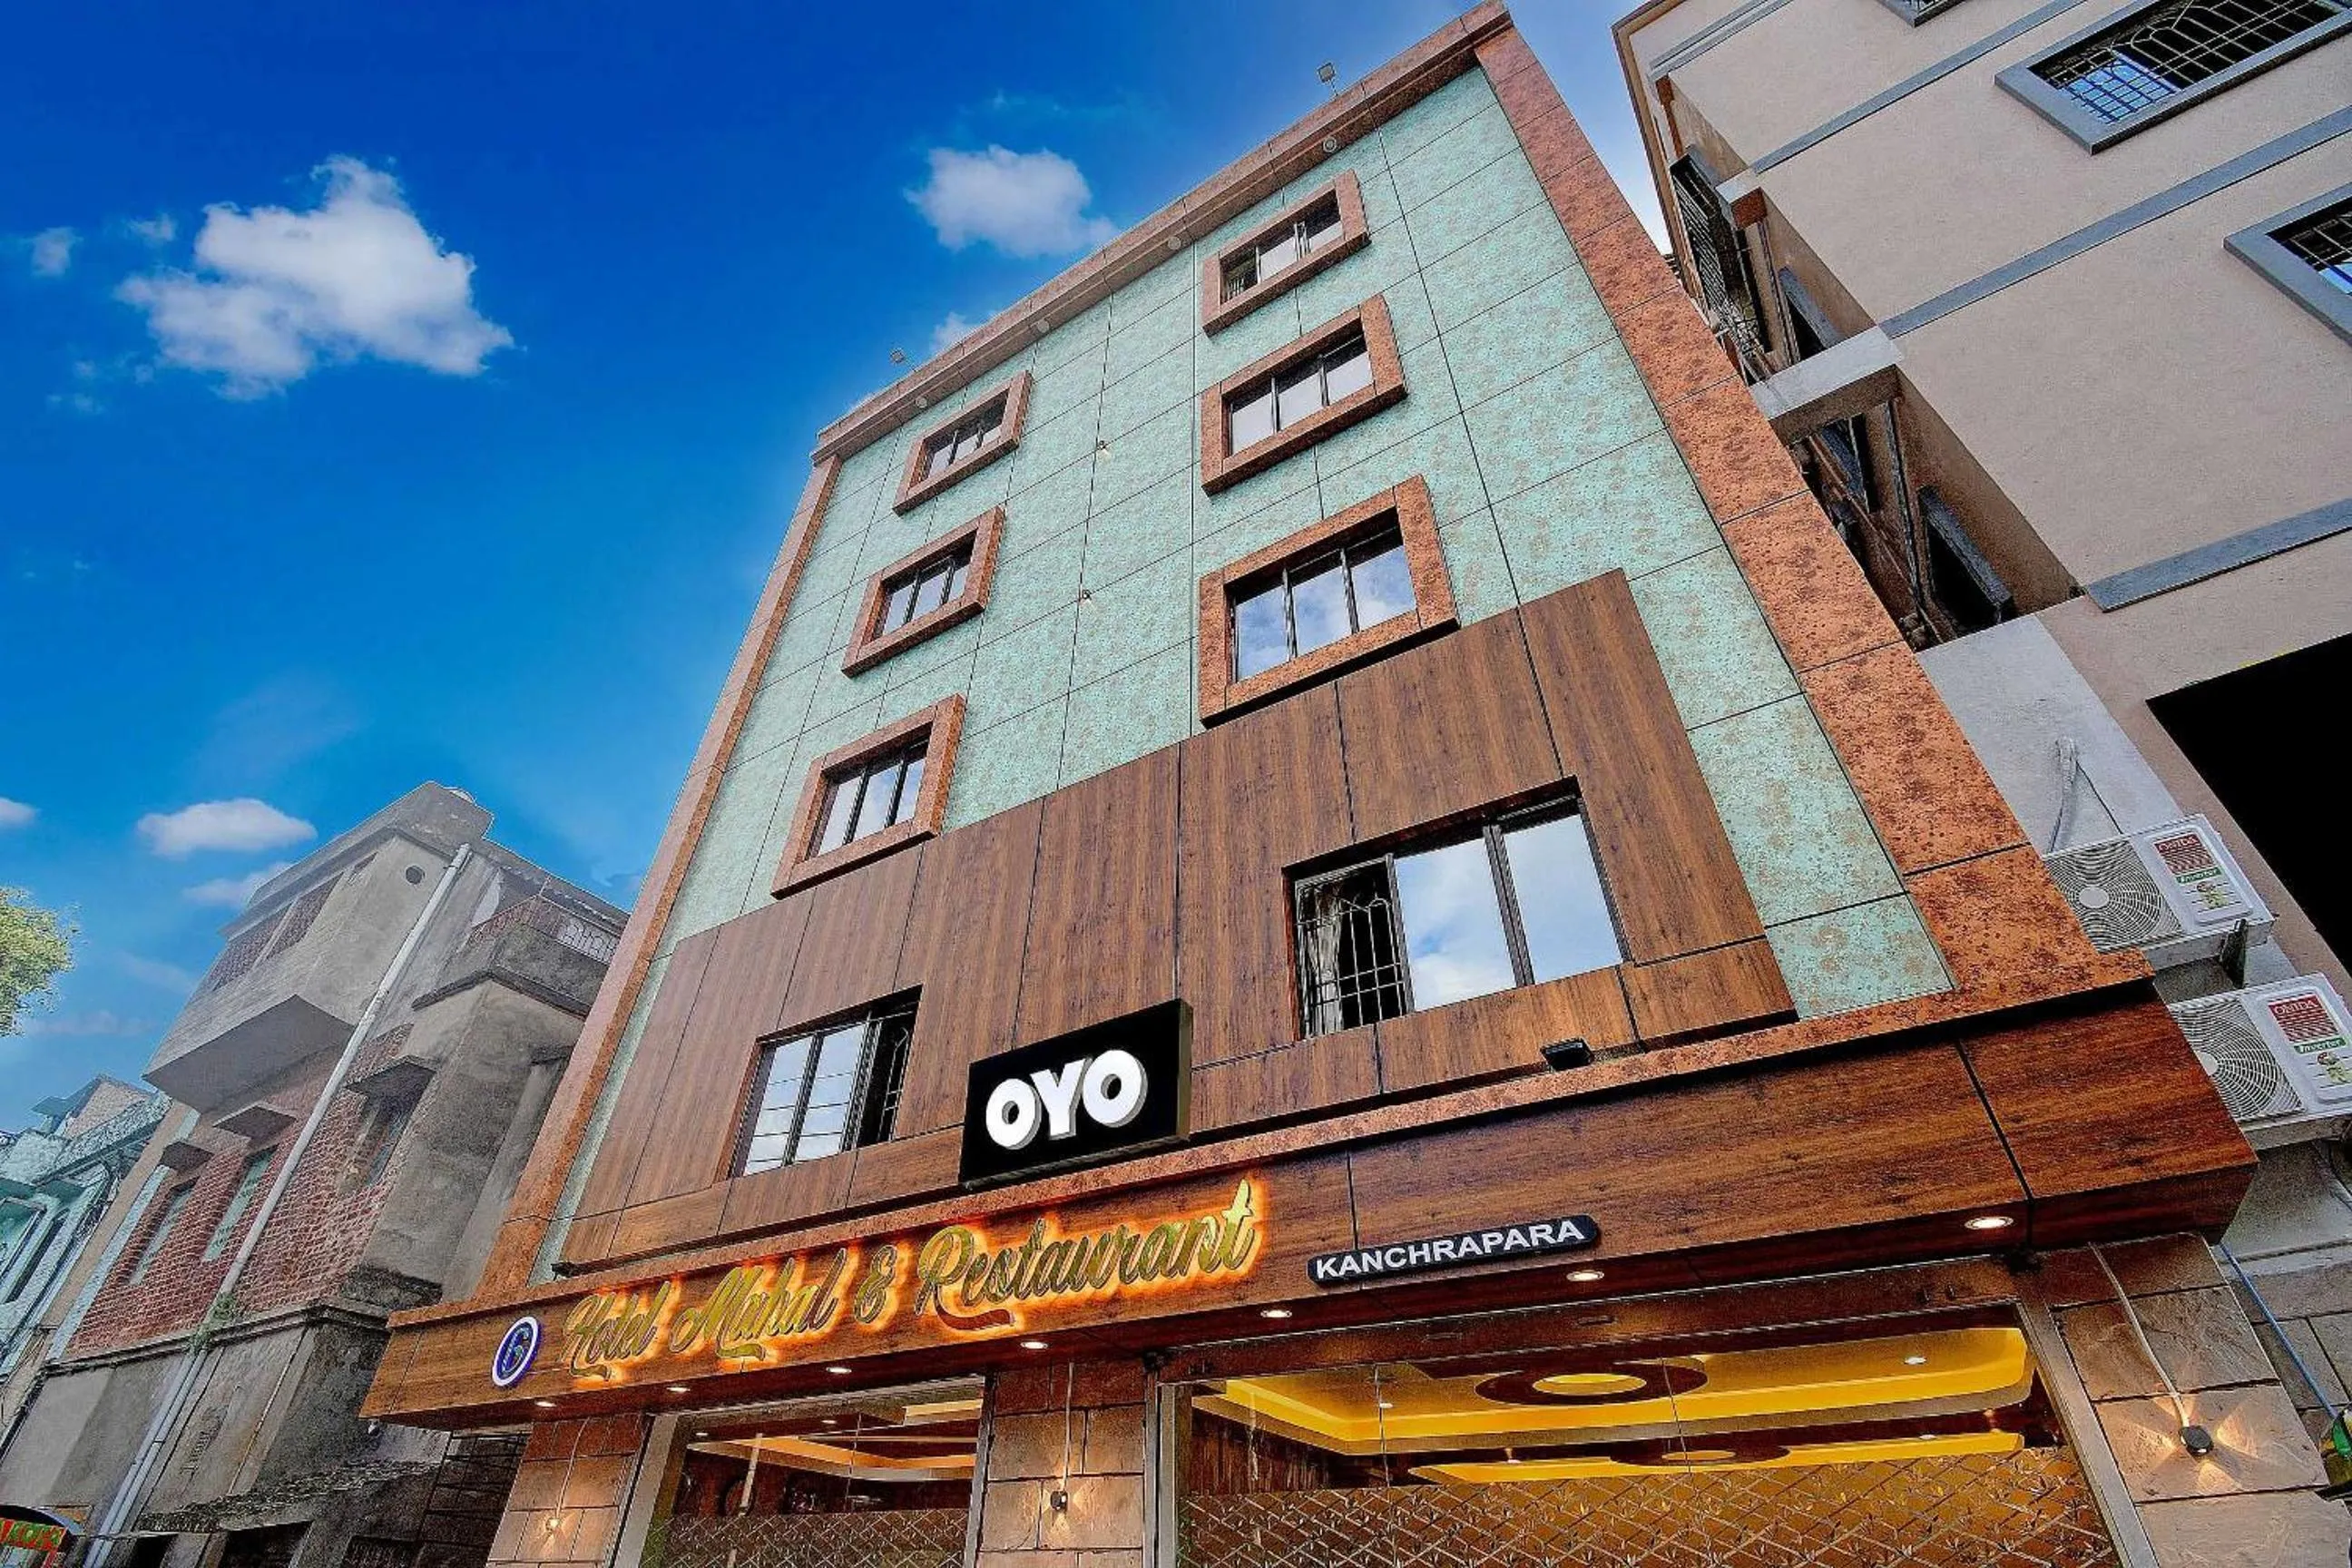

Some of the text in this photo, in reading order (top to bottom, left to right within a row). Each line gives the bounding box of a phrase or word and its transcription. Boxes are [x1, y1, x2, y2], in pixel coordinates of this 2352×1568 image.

[985, 1049, 1148, 1151] OYO
[560, 1180, 1255, 1379] Hotel Mahal & Restaurant
[1316, 1219, 1584, 1279] KANCHRAPARA
